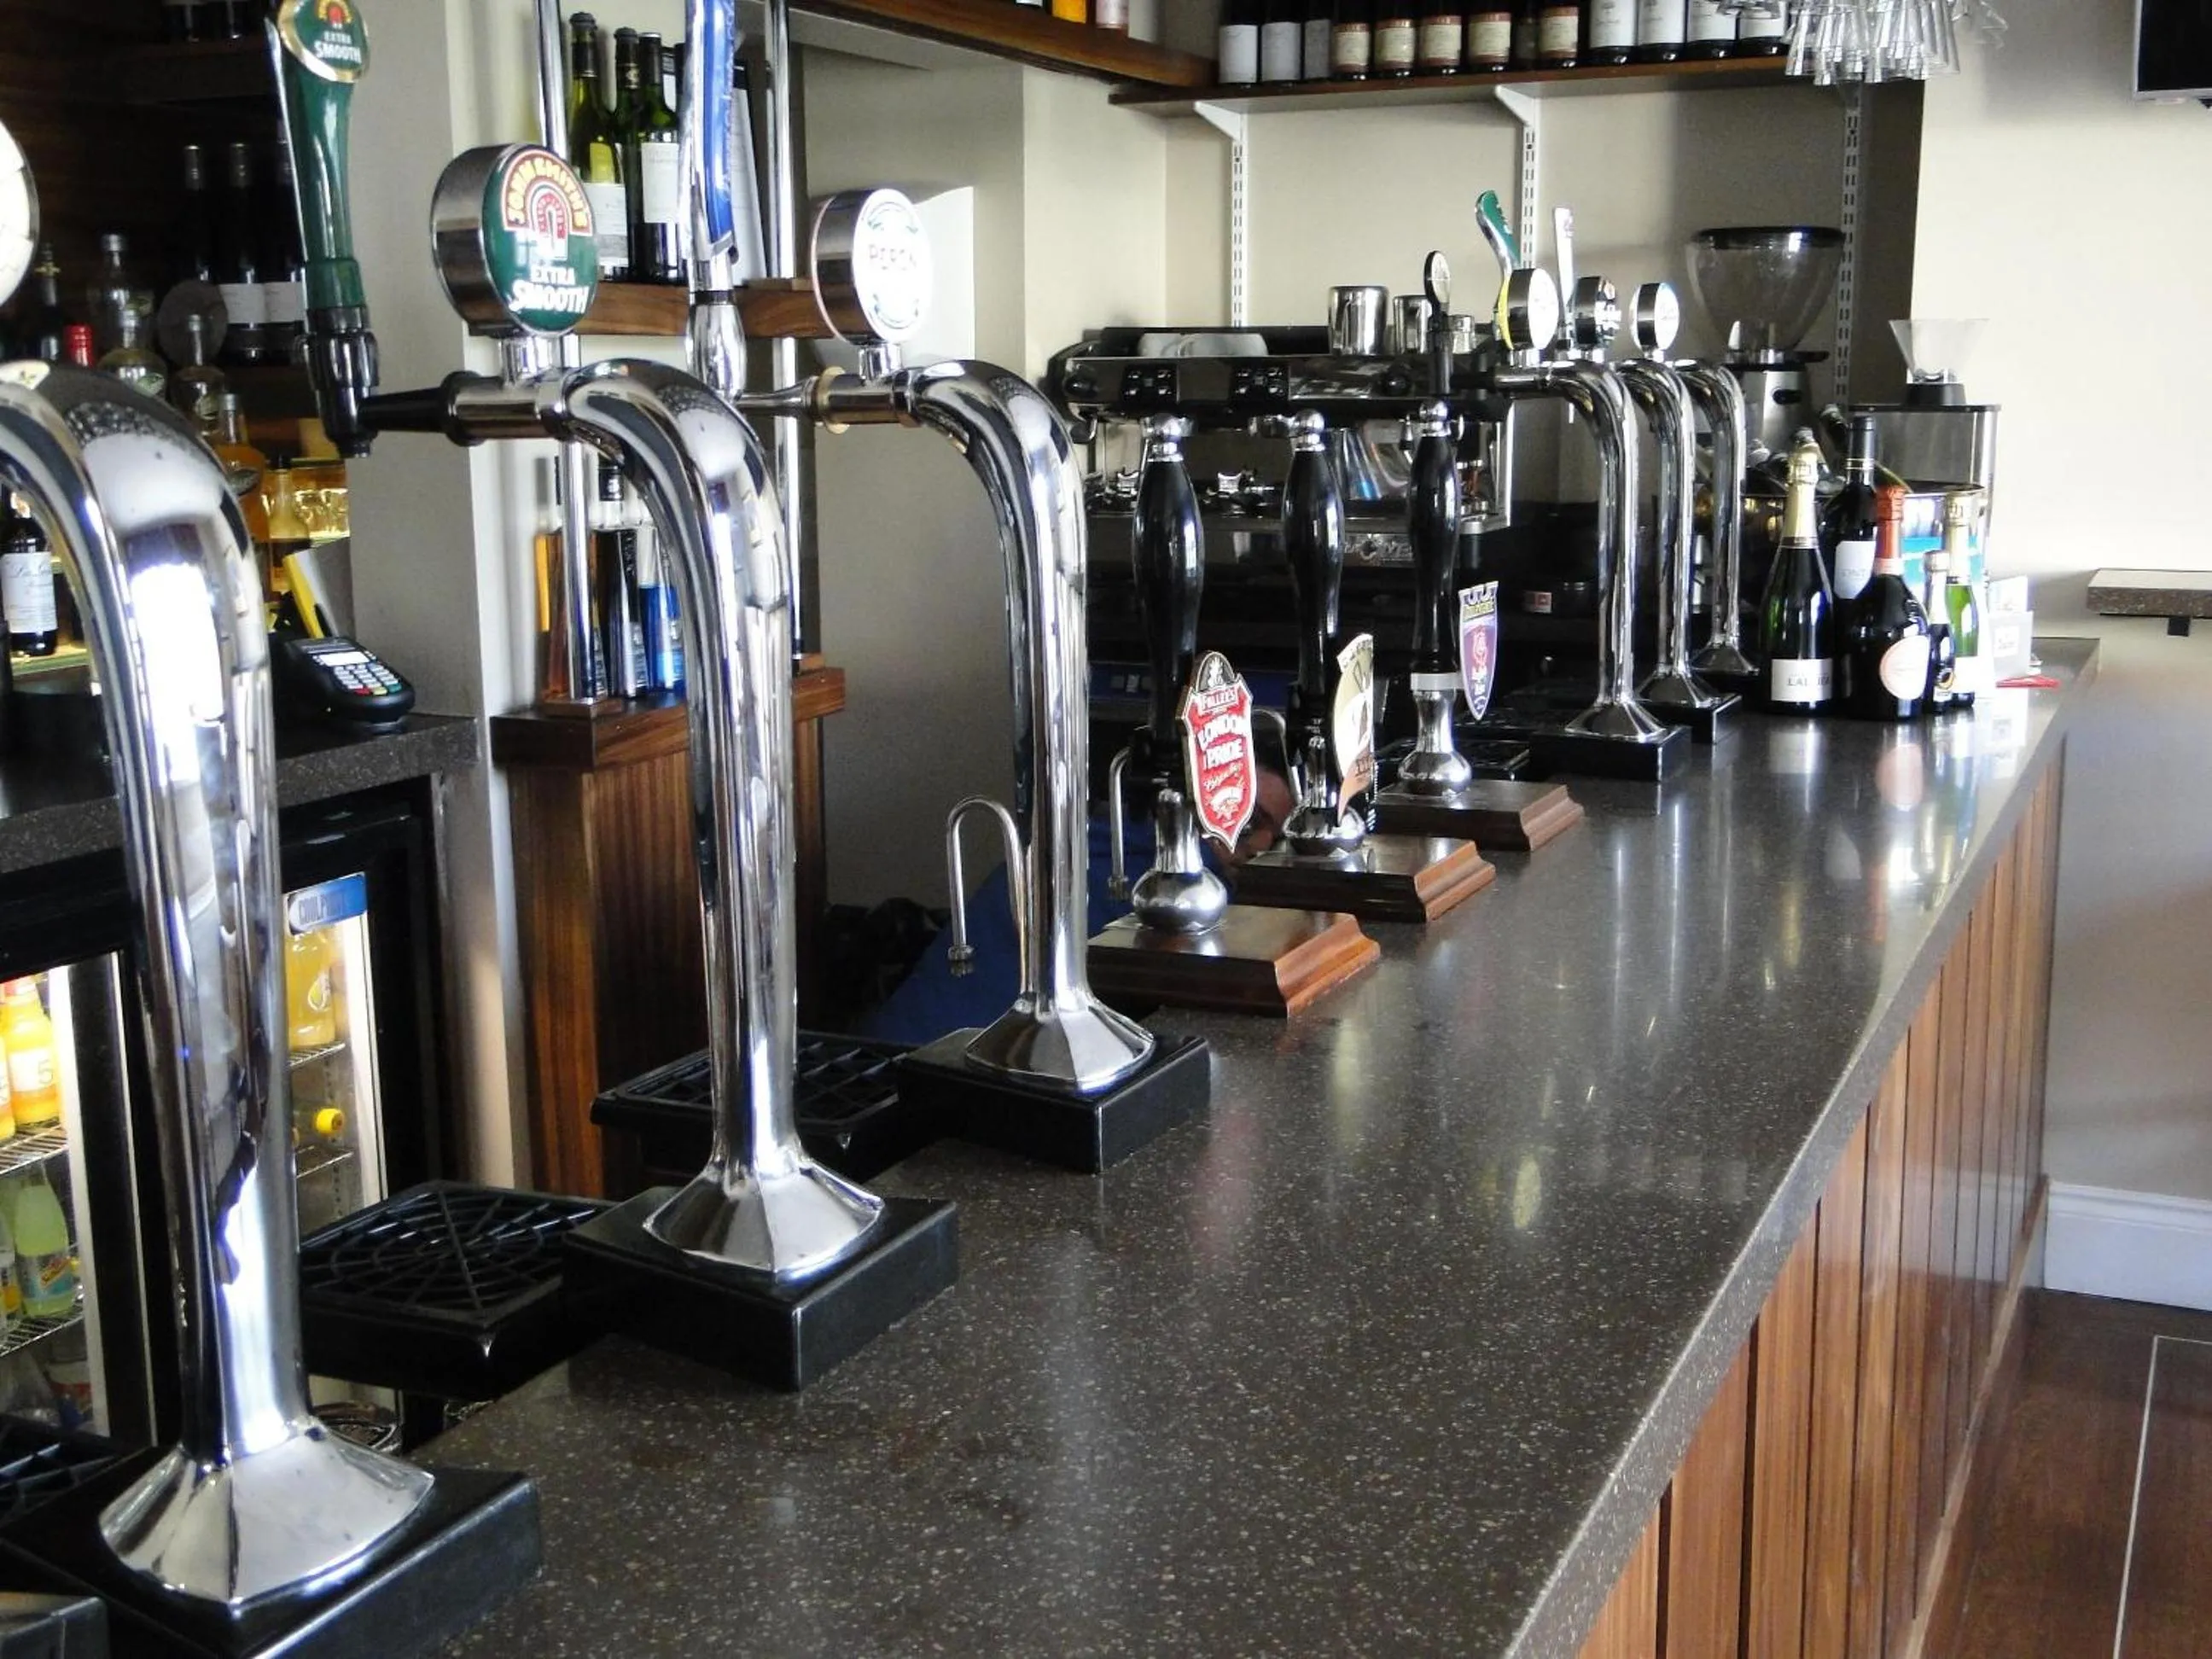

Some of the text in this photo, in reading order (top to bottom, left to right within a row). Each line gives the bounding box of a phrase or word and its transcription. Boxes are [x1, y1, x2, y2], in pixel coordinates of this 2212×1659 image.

[313, 40, 362, 64] SMOOTH
[530, 265, 576, 285] EXTRA
[509, 280, 589, 313] SMOOTH
[1197, 715, 1249, 751] LONDON
[1204, 736, 1244, 769] PRIDE
